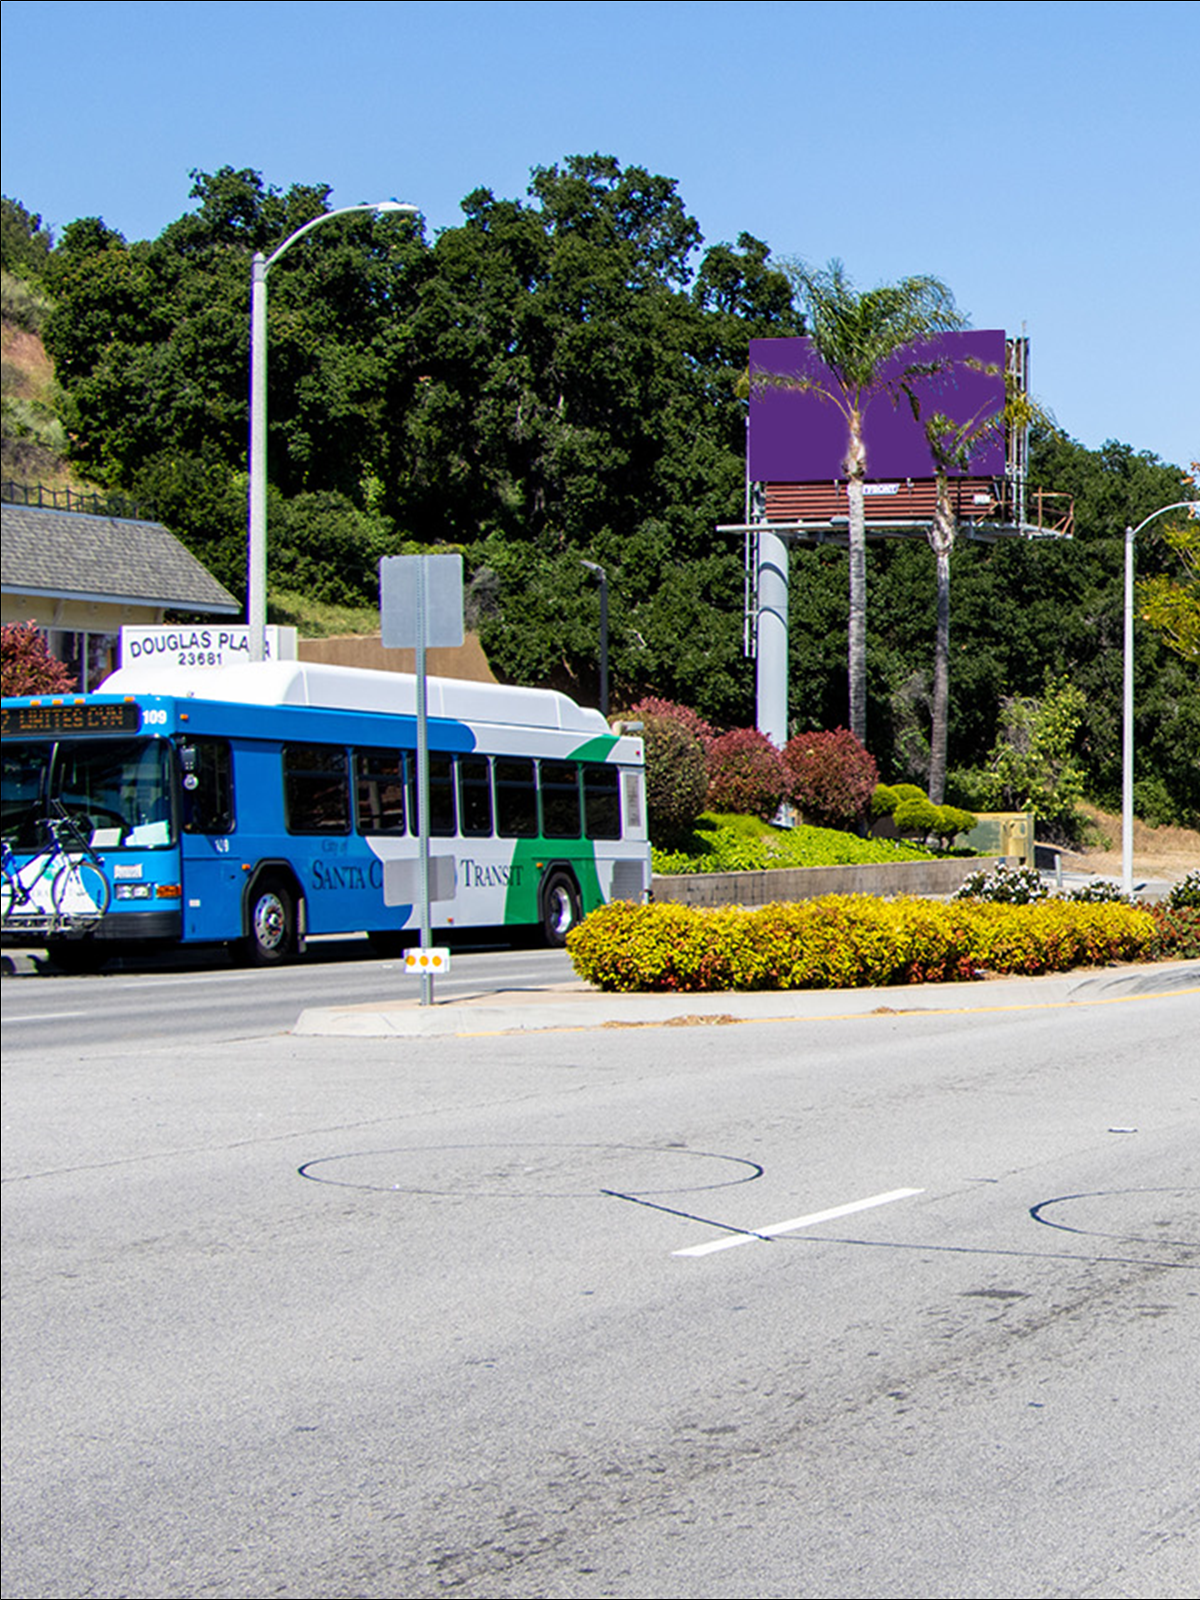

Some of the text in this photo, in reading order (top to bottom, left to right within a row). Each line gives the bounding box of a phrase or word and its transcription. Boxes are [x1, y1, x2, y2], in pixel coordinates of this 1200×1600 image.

[130, 631, 271, 658] DOUGLAS PLAA
[178, 652, 222, 666] 23681
[19, 708, 84, 729] WHITES
[87, 706, 124, 727] CYN
[142, 710, 168, 725] 109
